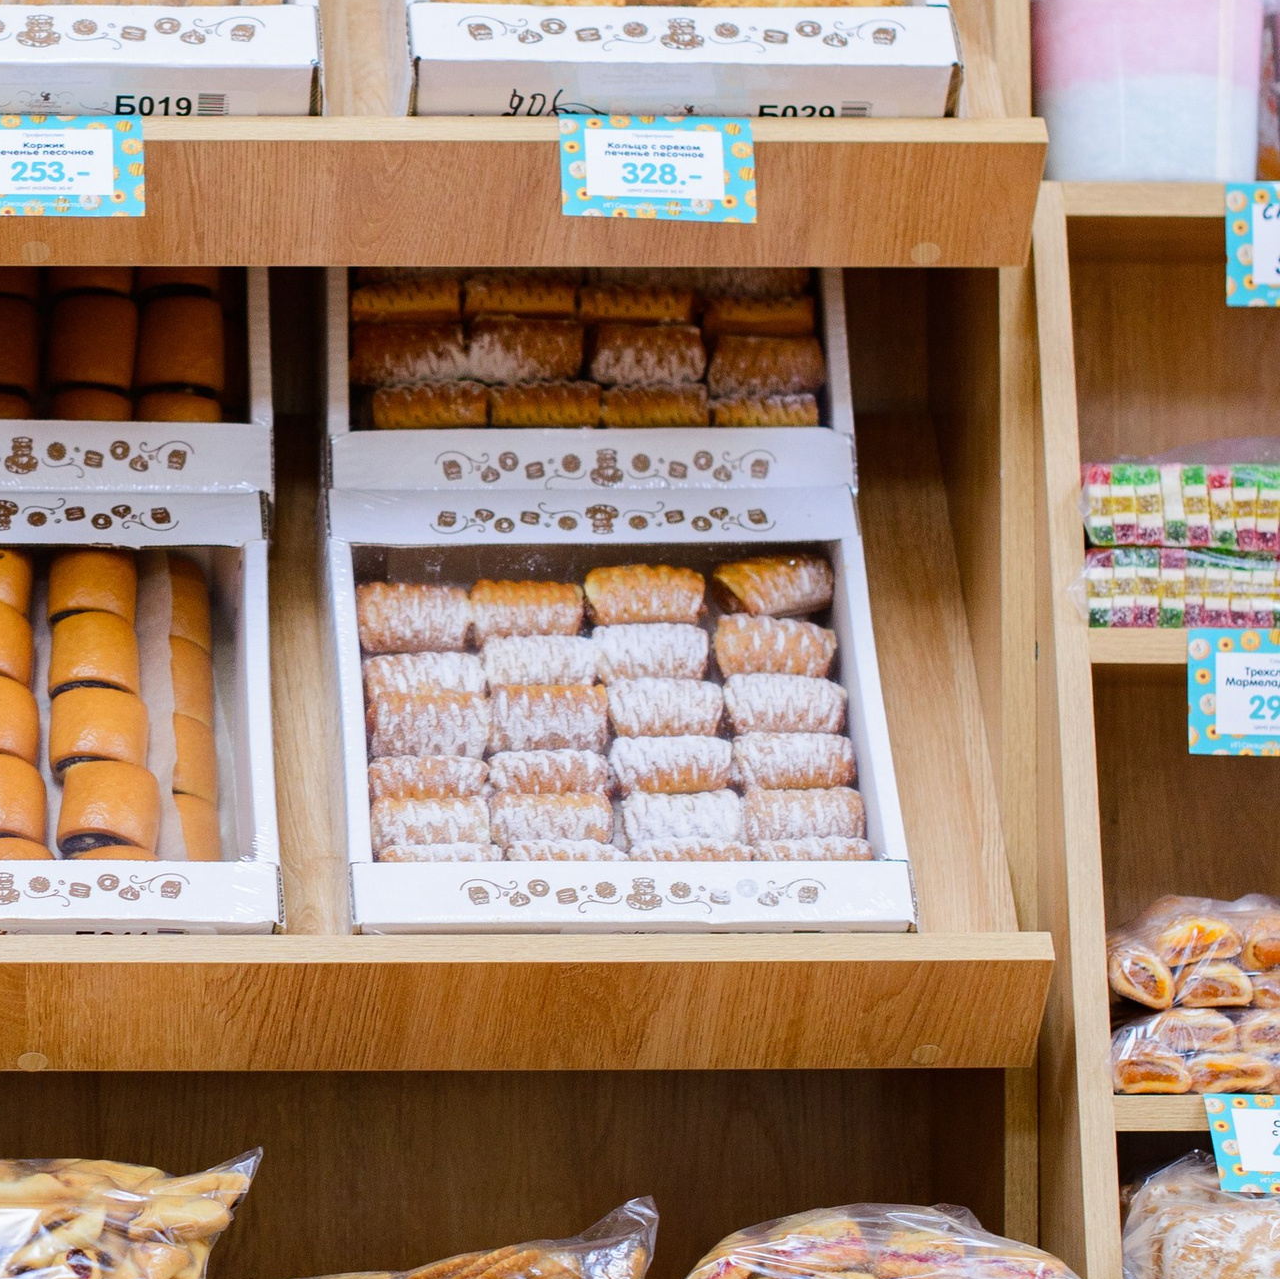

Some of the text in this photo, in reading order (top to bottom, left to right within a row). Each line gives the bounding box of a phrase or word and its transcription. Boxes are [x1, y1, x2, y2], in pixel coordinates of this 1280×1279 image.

[115, 95, 192, 116] Б019
[23, 142, 65, 151] Коржик
[607, 142, 648, 151] Кольцо
[660, 144, 701, 152] орехом
[10, 161, 90, 182] 253.-
[622, 162, 703, 185] 328.-
